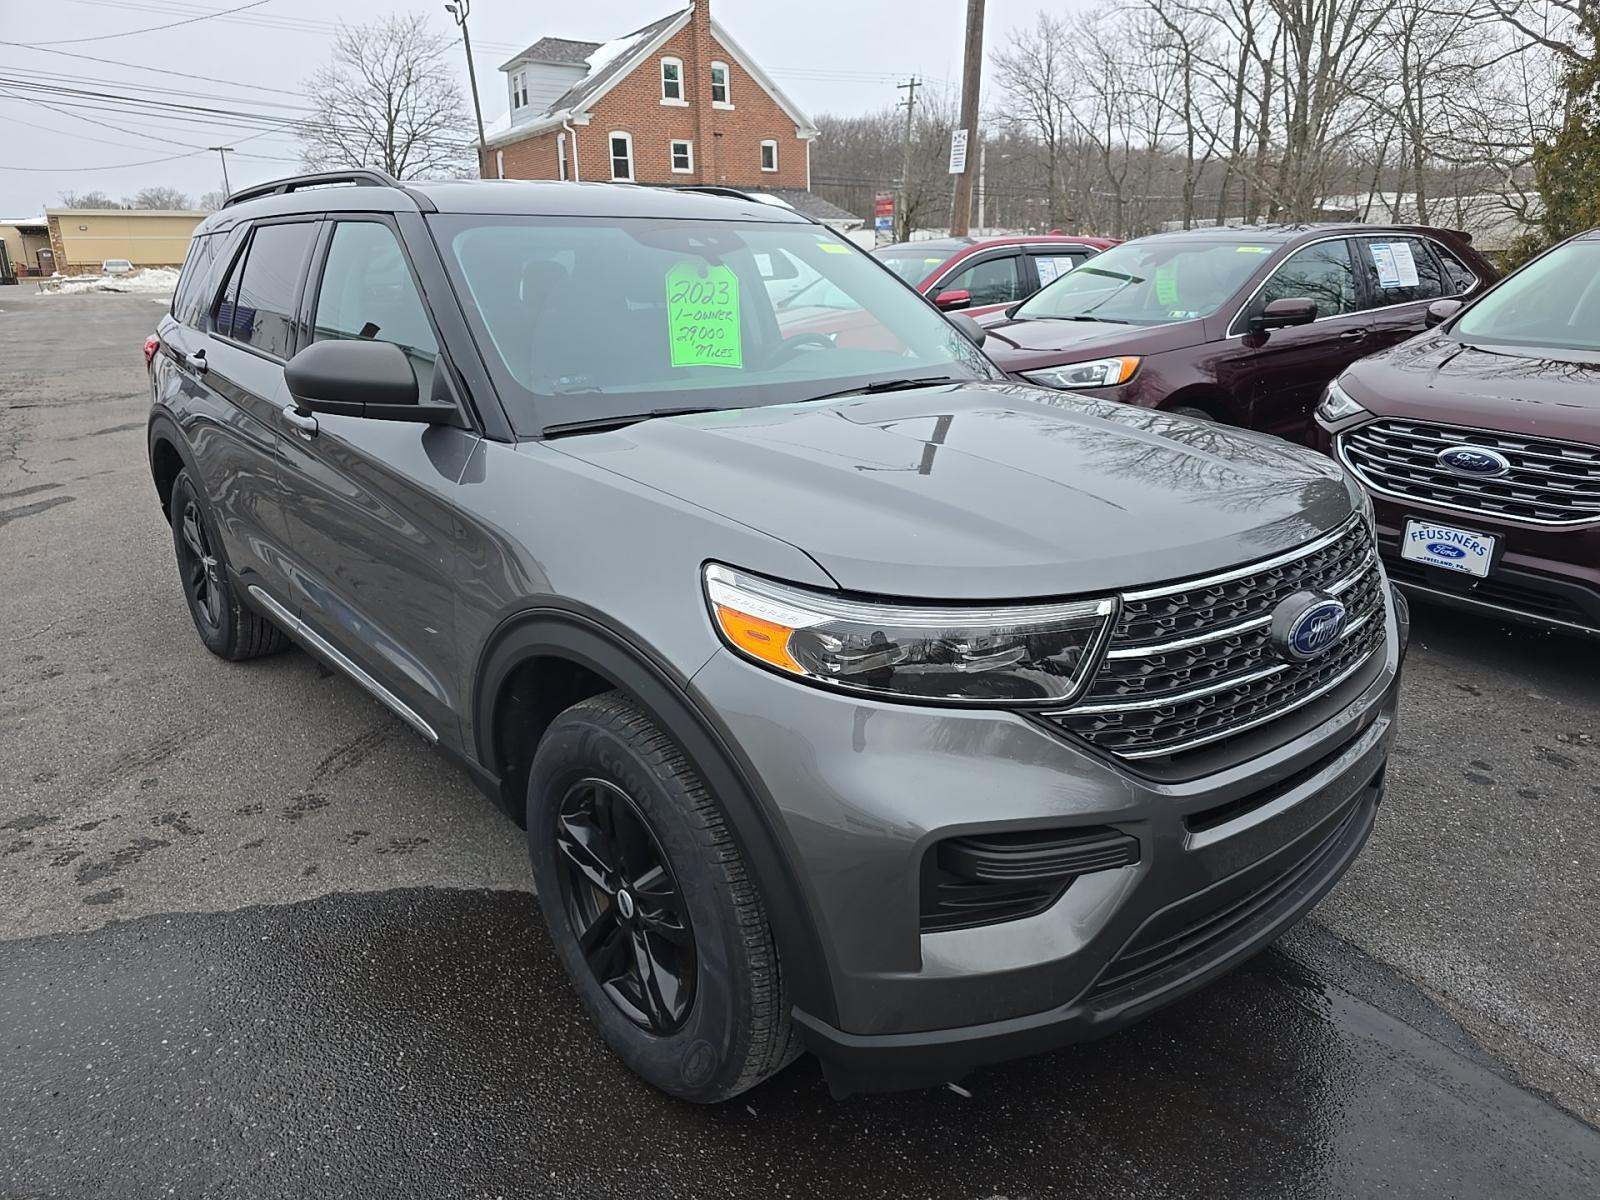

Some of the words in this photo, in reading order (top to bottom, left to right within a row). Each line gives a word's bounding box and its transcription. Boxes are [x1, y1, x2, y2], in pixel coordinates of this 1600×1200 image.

[671, 281, 729, 305] 2023
[675, 308, 734, 321] 1-OWNER
[1451, 452, 1490, 467] Ford
[1411, 529, 1487, 557] FEUSSNERS
[1432, 545, 1460, 558] Ford
